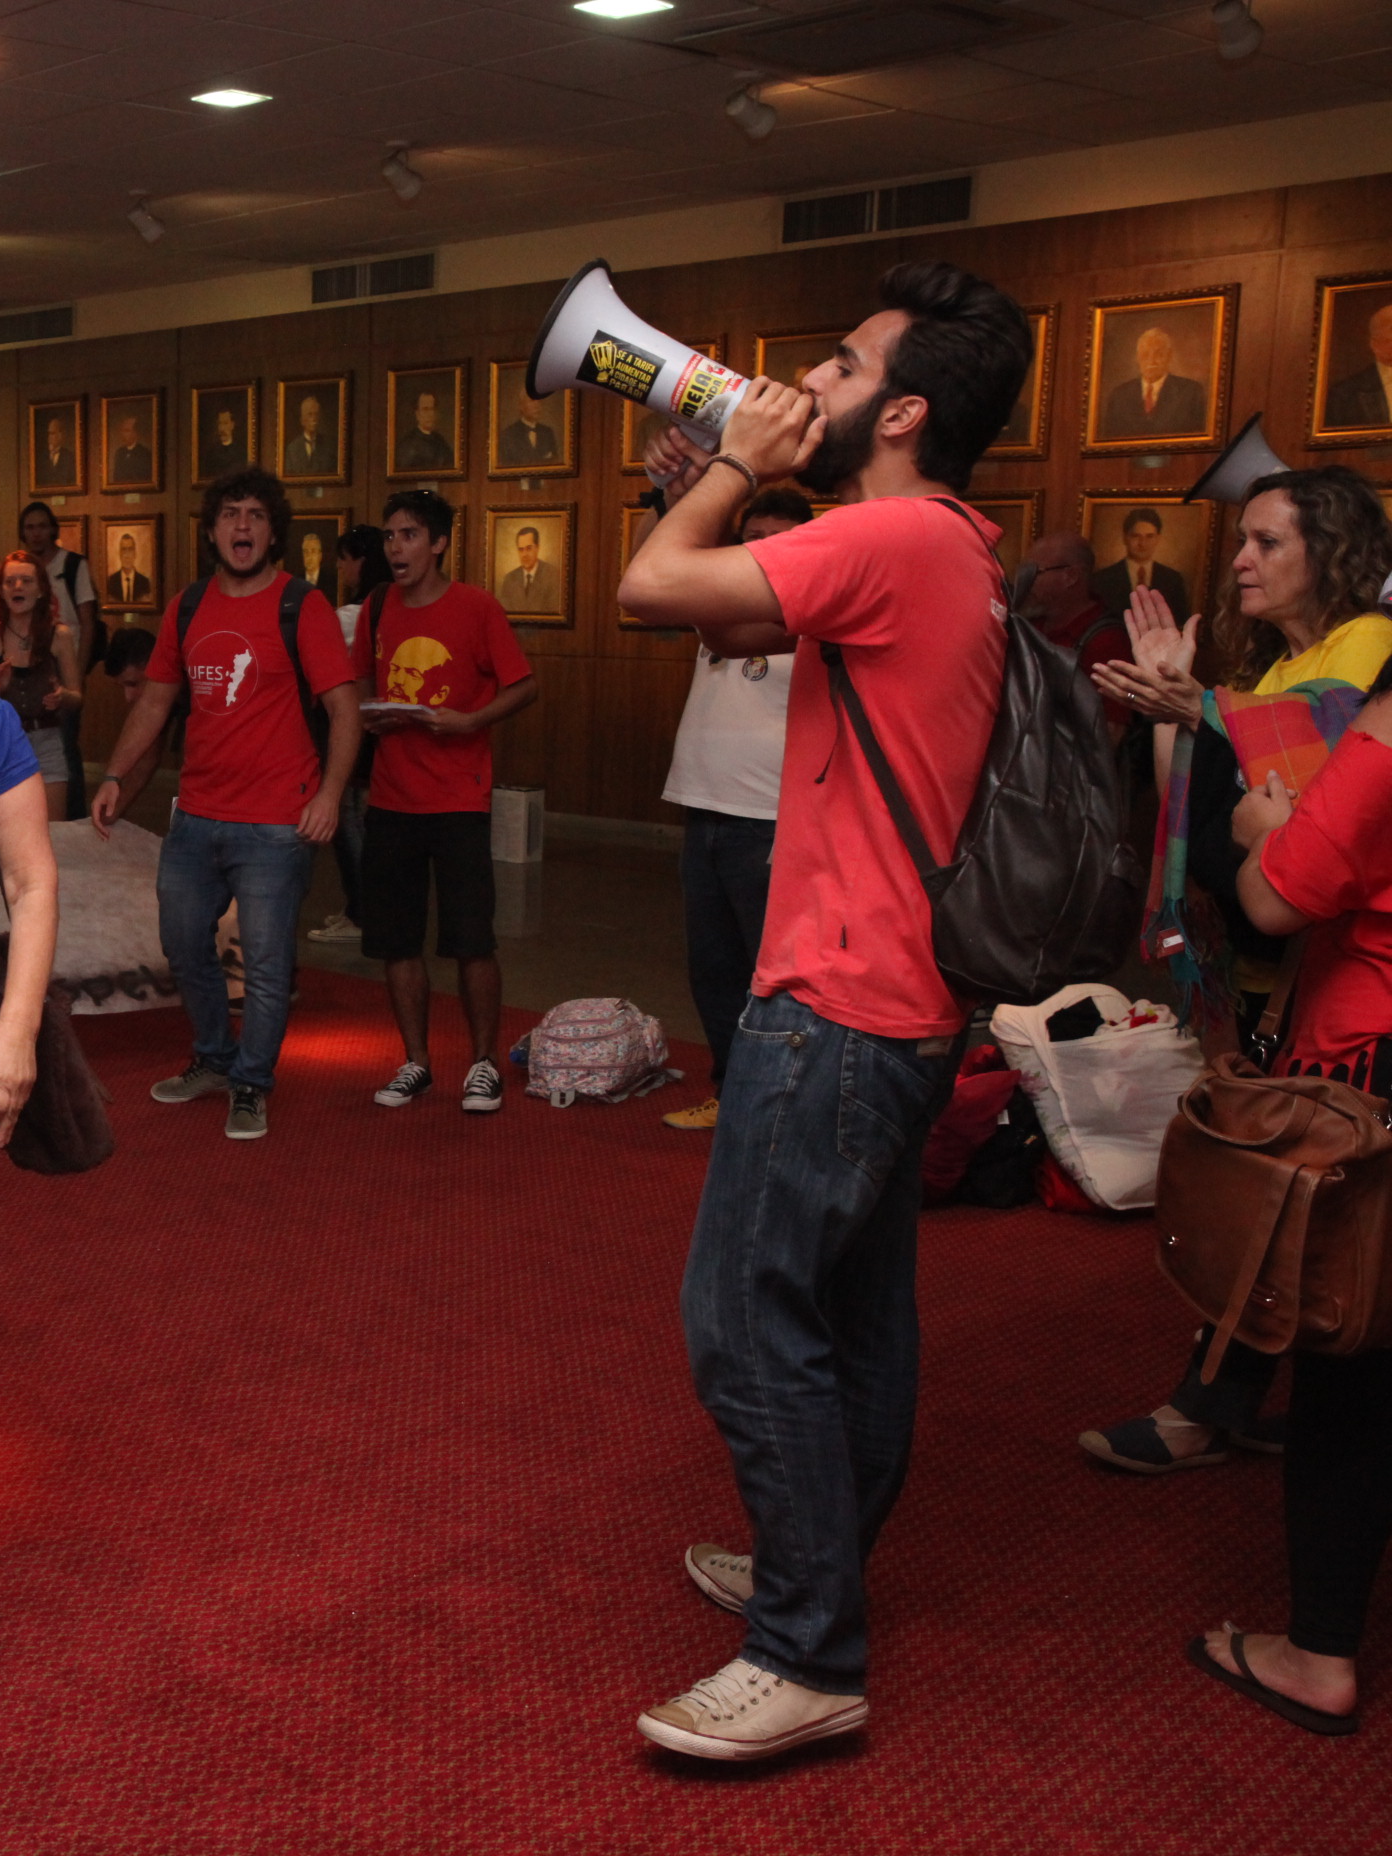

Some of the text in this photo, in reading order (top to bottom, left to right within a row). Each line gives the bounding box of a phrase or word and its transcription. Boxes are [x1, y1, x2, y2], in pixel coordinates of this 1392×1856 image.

[616, 350, 656, 374] SE A TARIFA
[616, 361, 652, 383] AUMENTAR
[614, 371, 638, 387] CIDADE
[681, 374, 712, 418] MEIA
[188, 665, 224, 681] UFES
